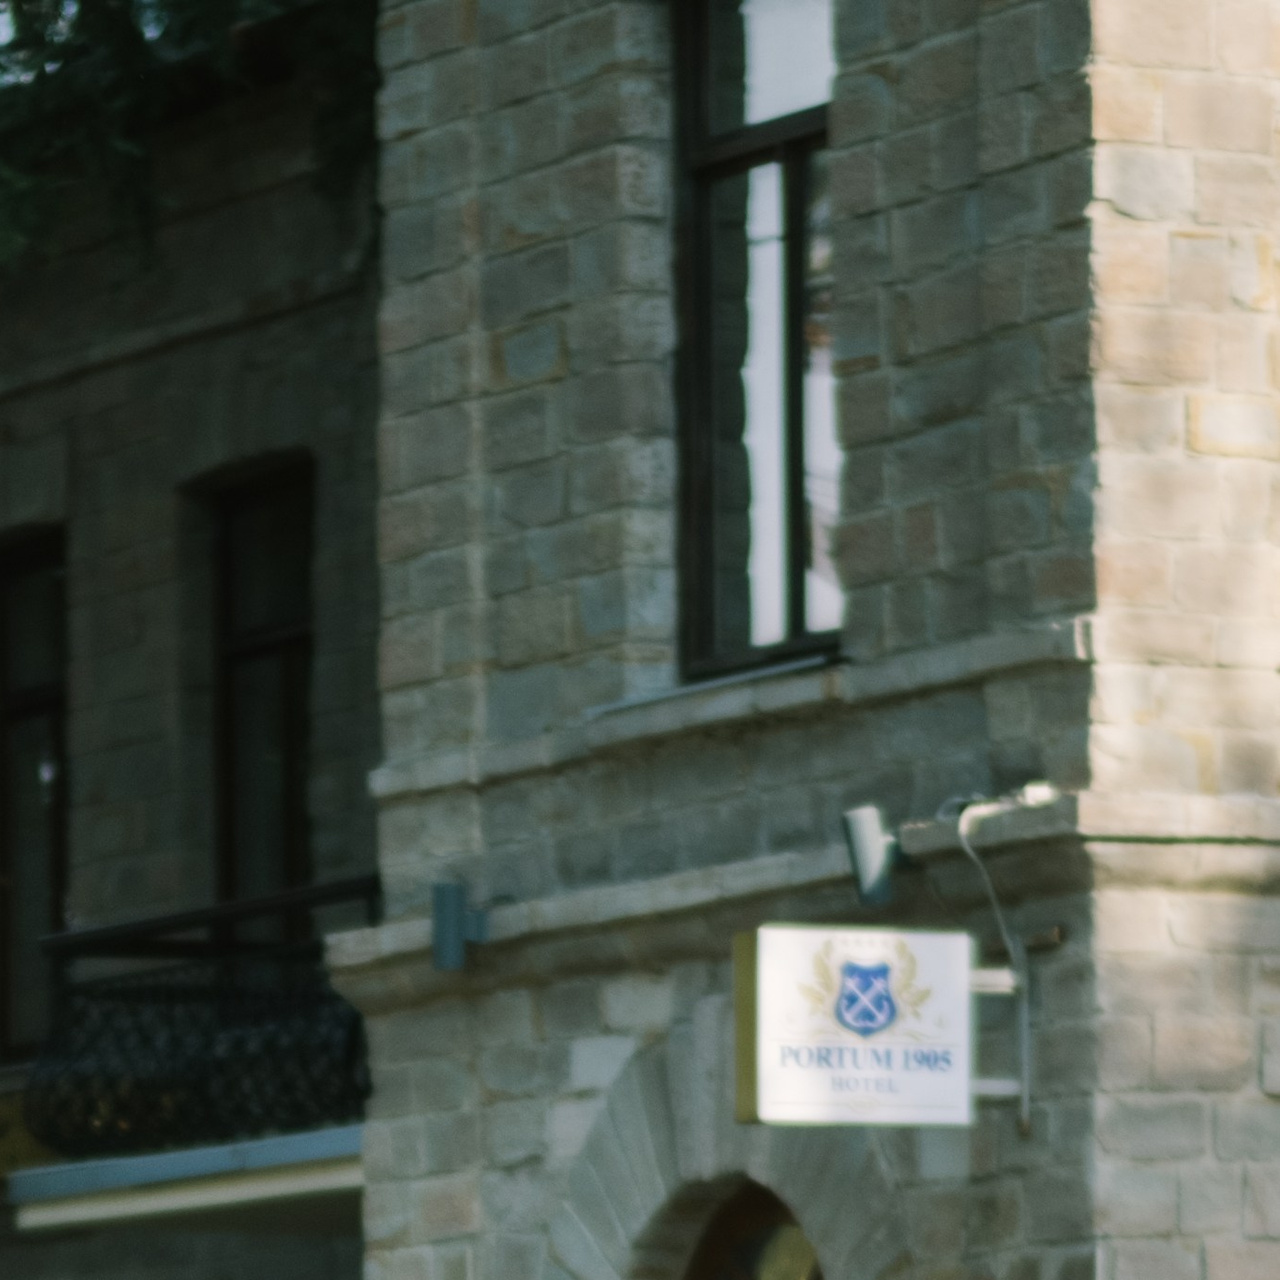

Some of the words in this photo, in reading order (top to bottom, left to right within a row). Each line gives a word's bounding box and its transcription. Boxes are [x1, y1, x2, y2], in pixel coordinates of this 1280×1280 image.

[779, 1045, 894, 1071] PORTUM
[902, 1048, 953, 1072] 1905
[830, 1076, 899, 1094] HOTEL
